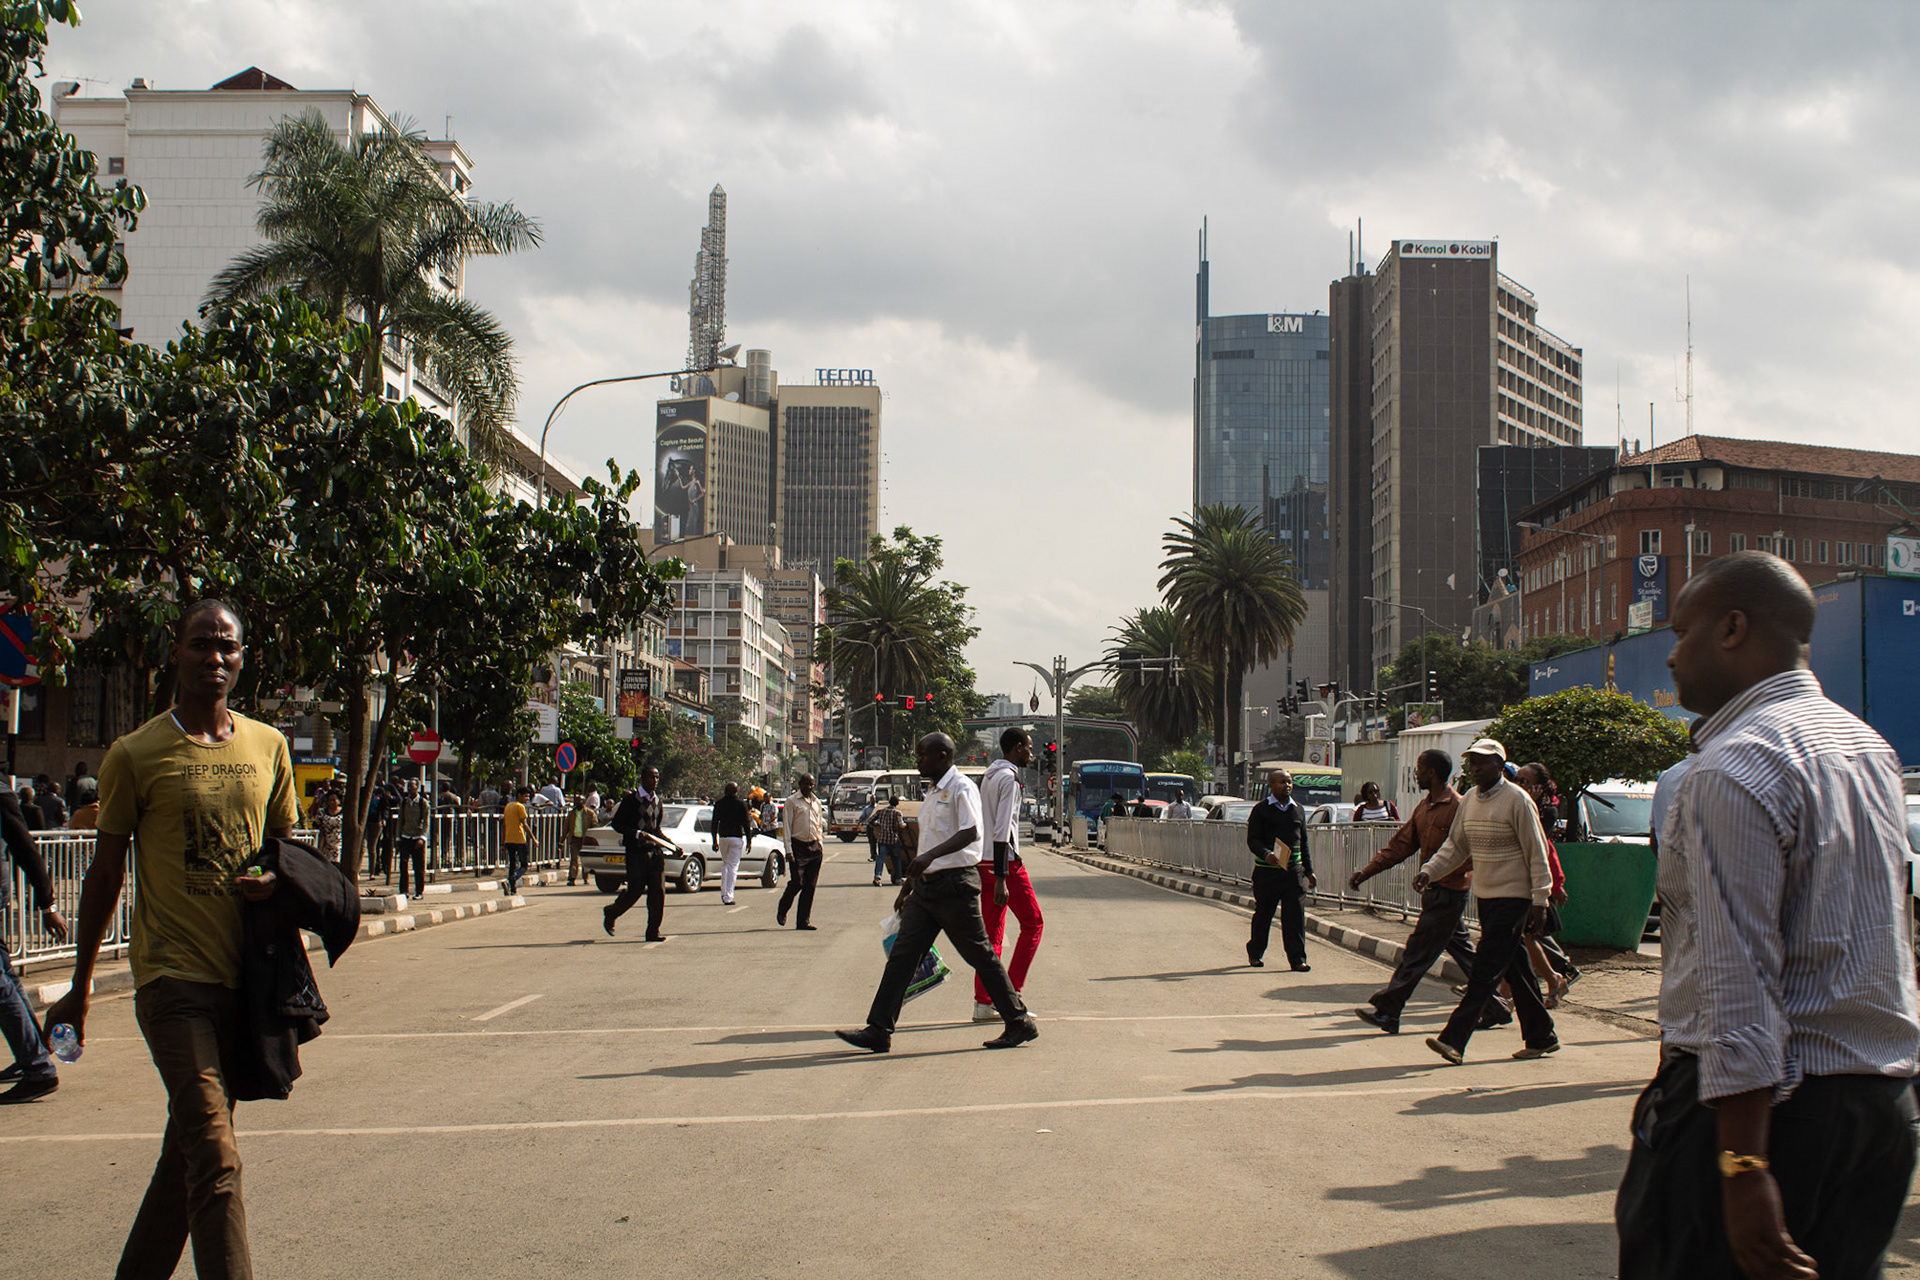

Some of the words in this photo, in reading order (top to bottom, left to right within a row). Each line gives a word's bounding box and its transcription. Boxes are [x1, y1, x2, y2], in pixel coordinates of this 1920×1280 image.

[1414, 244, 1447, 254] Kenol
[1461, 244, 1490, 255] Kobil
[815, 368, 873, 381] TECNO
[687, 437, 705, 445] Beauty
[906, 696, 915, 710] 8
[181, 764, 209, 776] JEEP
[212, 763, 257, 776] DRAGON
